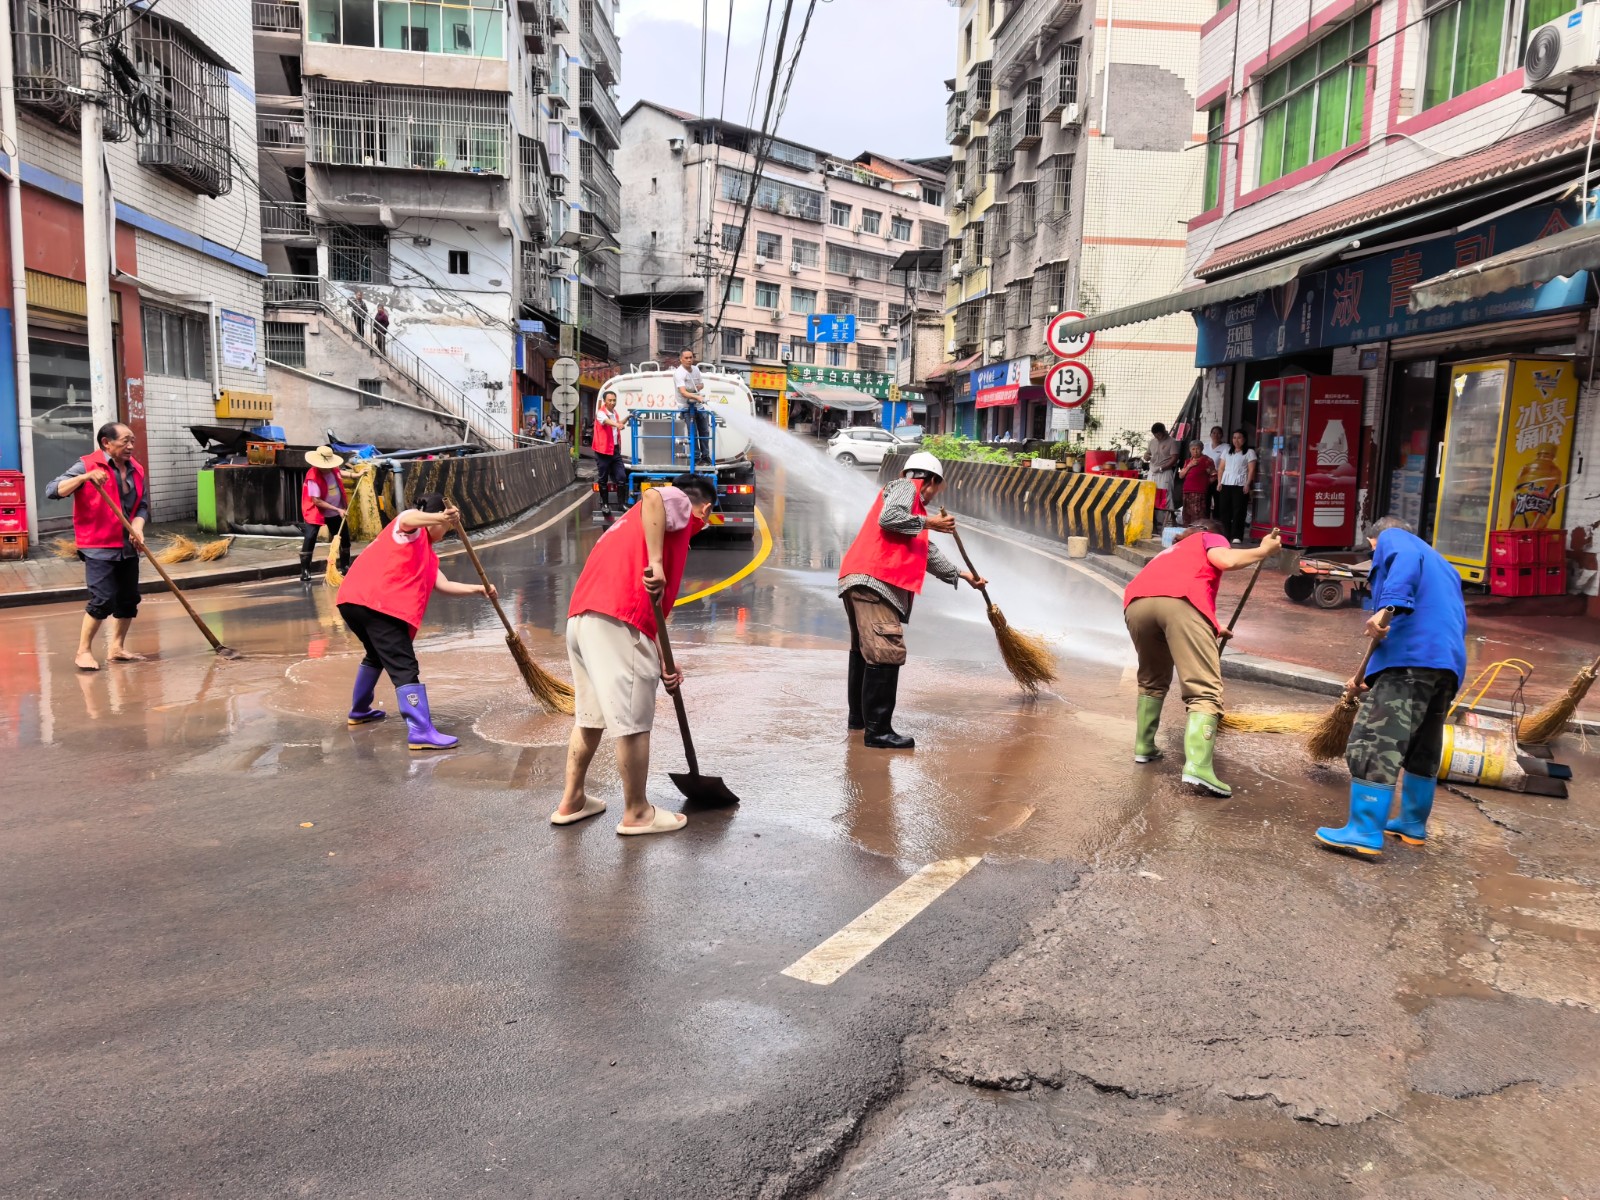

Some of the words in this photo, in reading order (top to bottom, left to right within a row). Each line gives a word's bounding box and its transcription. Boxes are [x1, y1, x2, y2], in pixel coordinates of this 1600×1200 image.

[1516, 398, 1567, 428] 冰爽
[1515, 422, 1563, 453] 痛快
[1315, 492, 1345, 500] 农夫山泉
